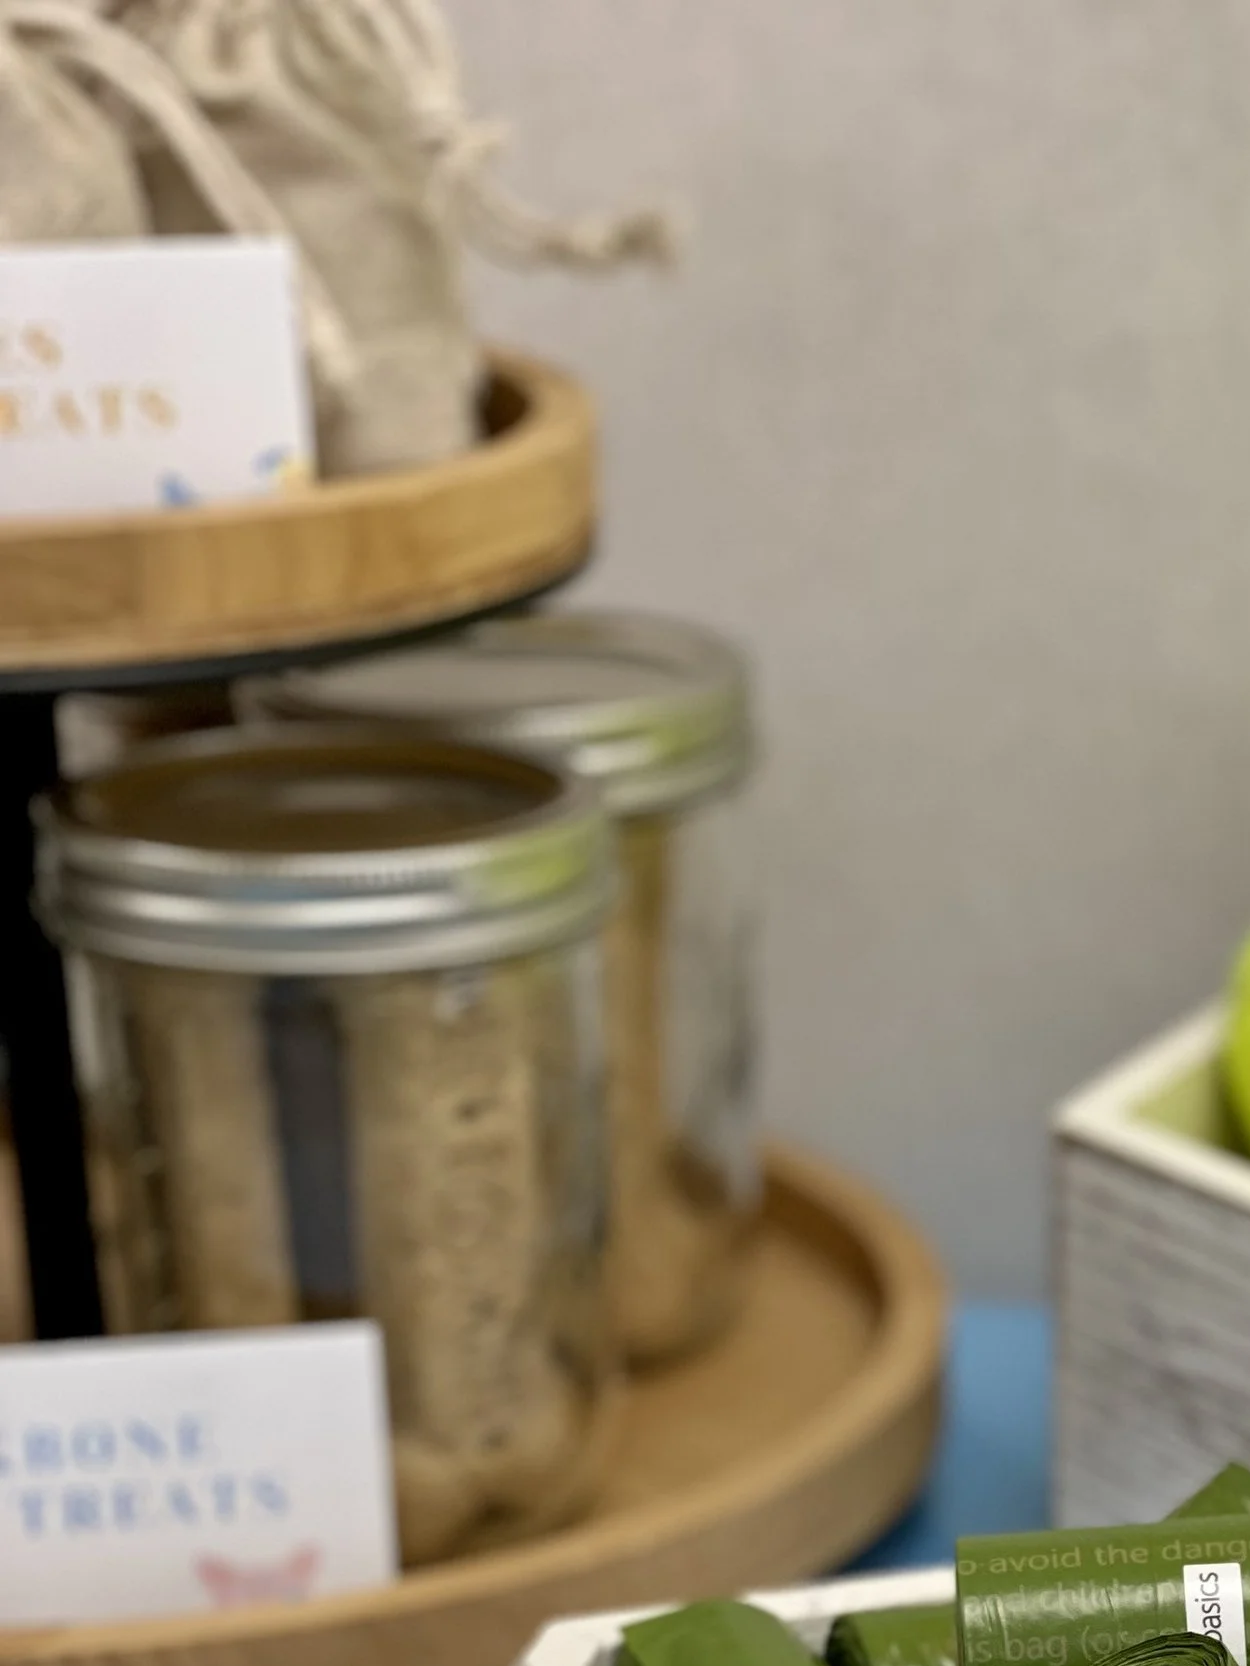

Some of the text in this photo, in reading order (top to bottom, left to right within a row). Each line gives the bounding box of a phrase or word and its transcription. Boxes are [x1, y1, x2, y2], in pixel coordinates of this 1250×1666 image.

[989, 1546, 1081, 1573] avoid
[1095, 1543, 1149, 1566] the
[1002, 1624, 1068, 1666] bag
